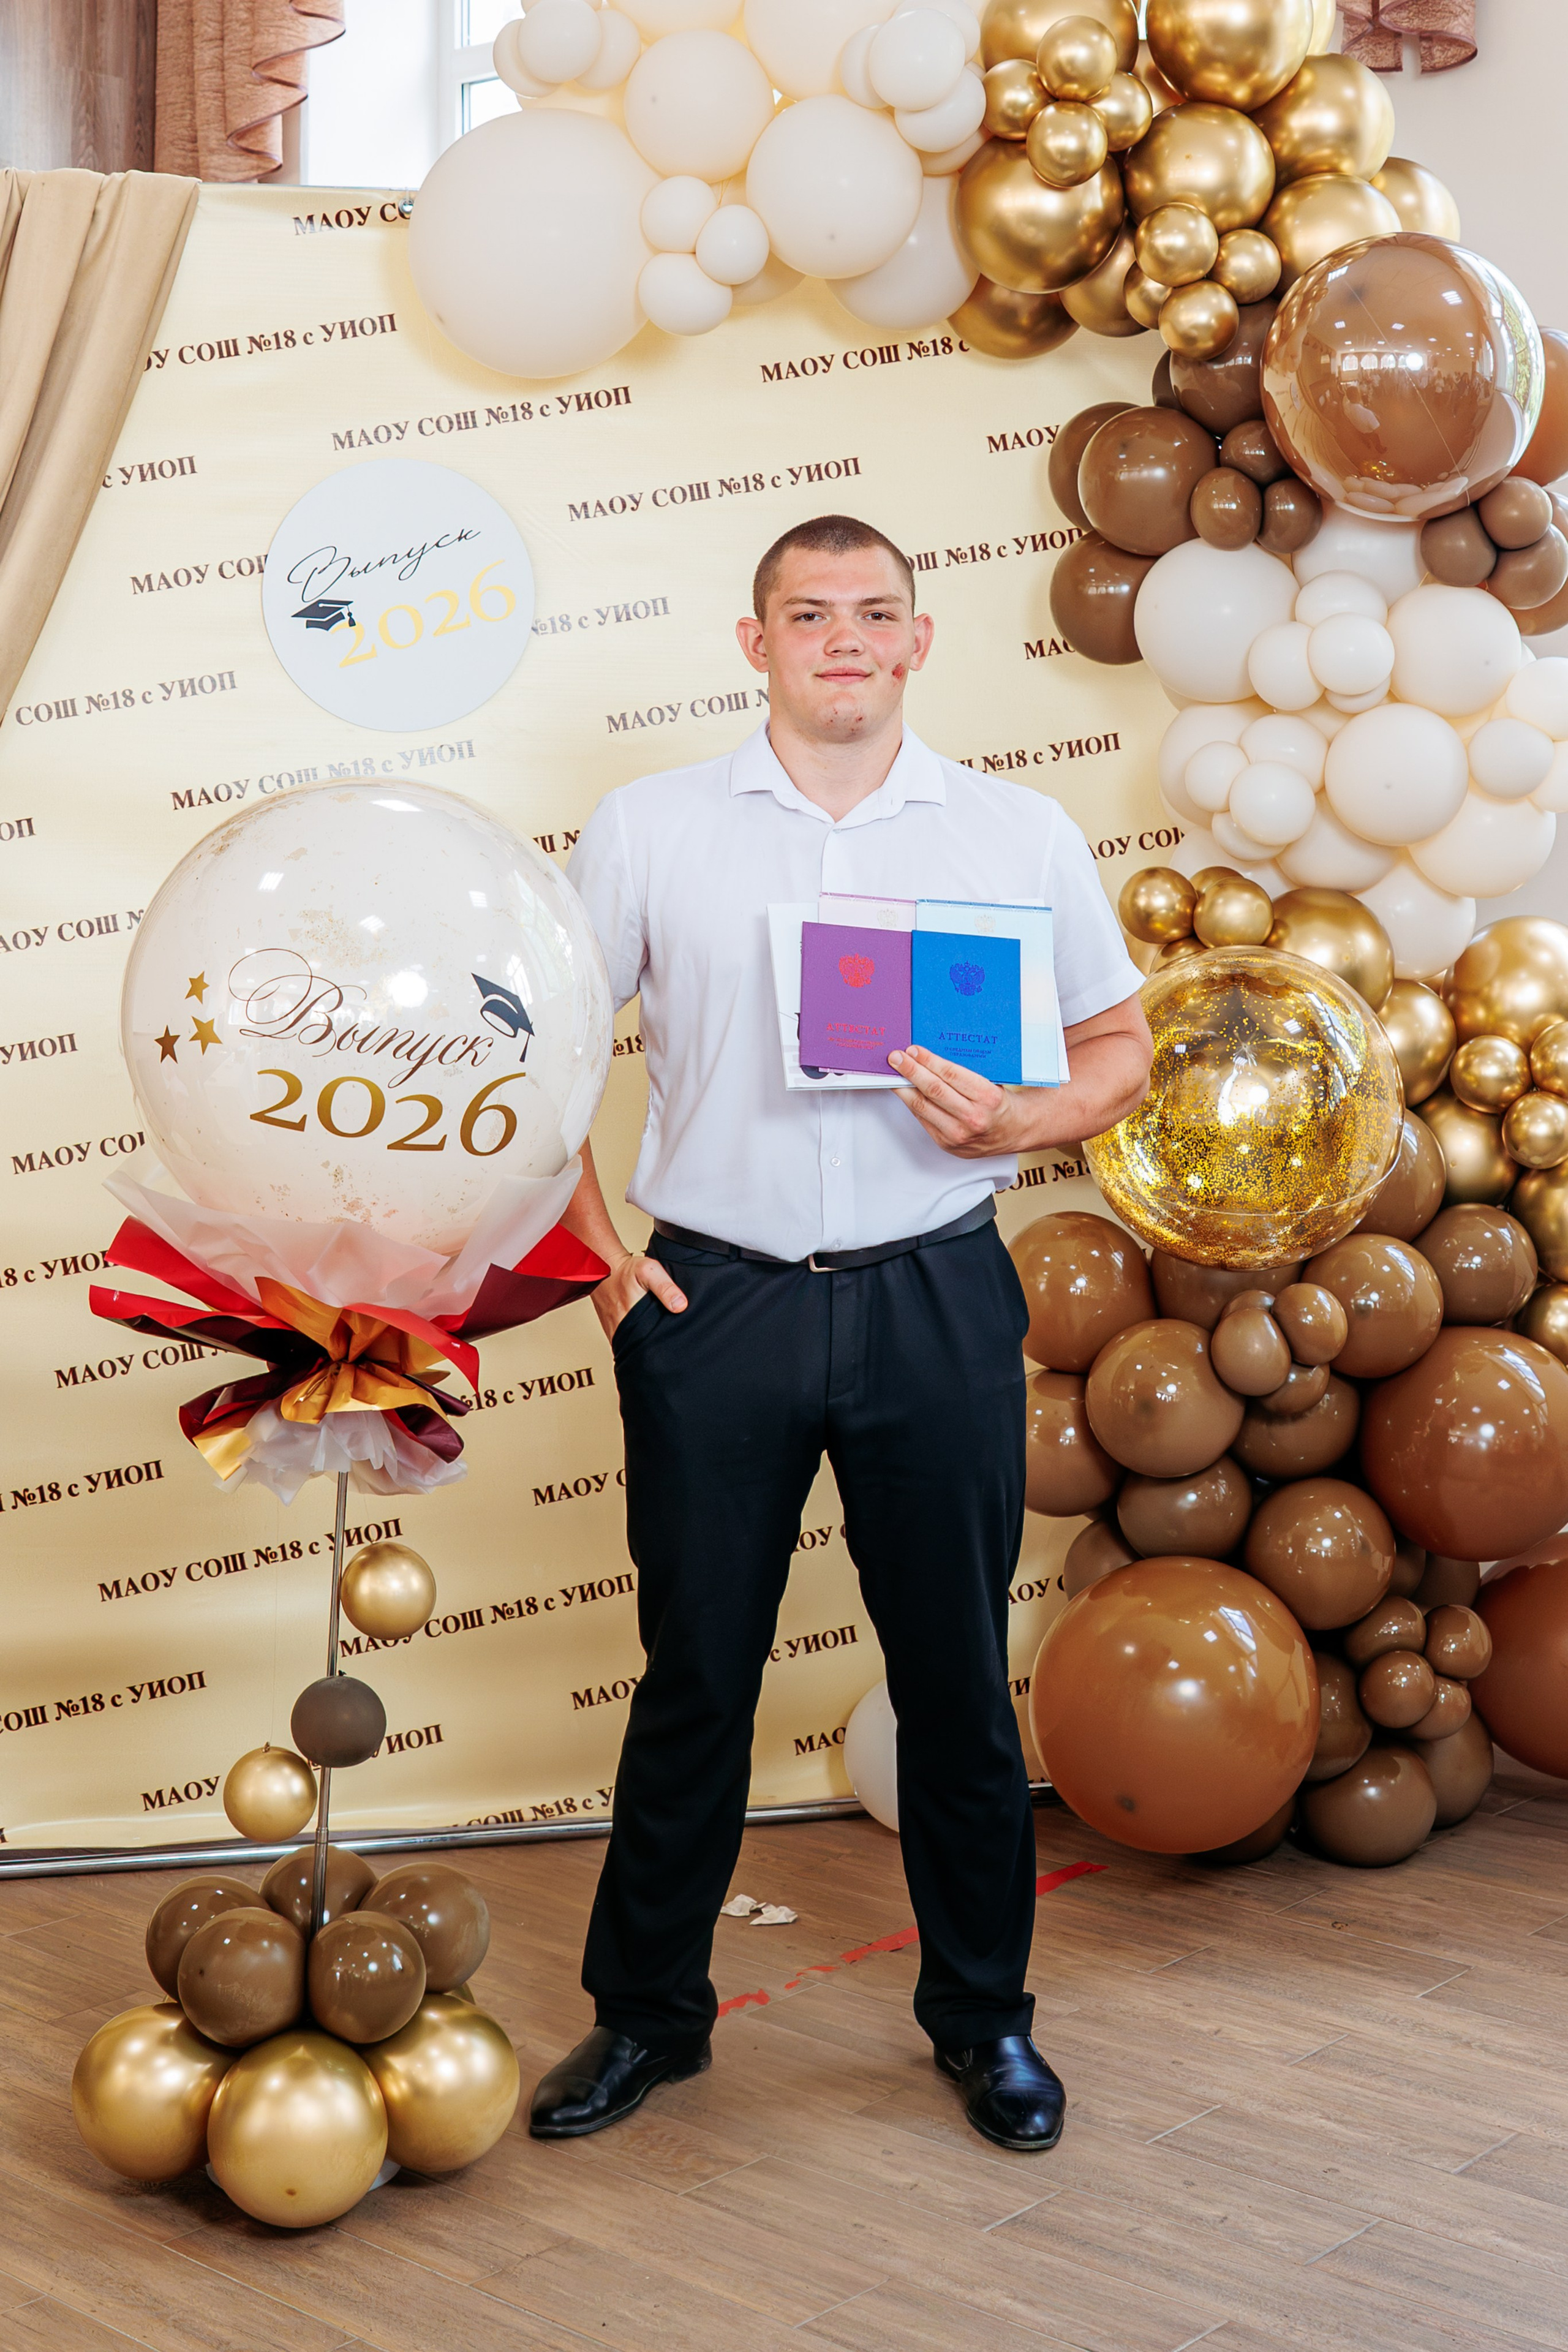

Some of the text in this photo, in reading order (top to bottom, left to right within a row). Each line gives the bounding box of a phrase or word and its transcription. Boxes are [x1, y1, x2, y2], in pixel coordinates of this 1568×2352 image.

[293, 206, 371, 235] МАОУ
[179, 339, 240, 364] СОШ
[247, 330, 296, 354] №18
[303, 330, 315, 346] с
[320, 314, 397, 342] УИОП
[761, 355, 834, 382] МАОУ
[843, 344, 900, 369] СОШ
[907, 337, 953, 360] №18
[332, 386, 631, 450] МАОУ СОШ №18 с УИОП
[986, 425, 1060, 454] МАОУ
[102, 456, 198, 489] с УИОП
[568, 458, 861, 521] МАОУ СОШ №18 с УИОП
[287, 527, 481, 603] Выпуск
[909, 552, 939, 573] ОШ
[944, 543, 990, 567] №18
[997, 546, 1007, 557] с
[130, 565, 209, 594] МАОУ
[331, 559, 516, 668] 2026
[578, 616, 588, 628] с
[594, 597, 670, 625] УИОП
[1023, 637, 1076, 660] МА
[15, 671, 237, 725] СОШ №18 с УИОП
[606, 703, 682, 733] МАОУ
[690, 692, 749, 717] СОШ
[982, 750, 1027, 773] №18
[1033, 752, 1043, 764] с
[1048, 733, 1120, 761] УИОП
[170, 739, 477, 810] МАОУ СОШ №18 с УИОП
[0, 818, 35, 840] ОП
[1088, 836, 1131, 859] ОУ
[0, 927, 48, 952] АОУ
[58, 914, 119, 941] СОШ
[228, 948, 494, 1088] Выпуск
[827, 1022, 886, 1036] АТТЕСТАТ
[0, 1033, 78, 1065] УИОП
[938, 1032, 998, 1044] АТТЕСТАТ
[249, 1069, 527, 1156] 2026
[12, 1132, 145, 1174] МАОУ СО
[995, 1160, 1090, 1194] ОШ №1
[24, 1270, 36, 1283] с
[54, 1354, 134, 1388] МАОУ
[142, 1343, 205, 1370] СОШ
[503, 1391, 514, 1403] с
[518, 1368, 595, 1400] УИОП
[10, 1482, 61, 1509] №18
[68, 1484, 79, 1497] с
[84, 1460, 164, 1493] УИОП
[532, 1472, 608, 1506] МАОУ
[794, 1526, 833, 1552] ОУ
[97, 1567, 178, 1602] МАОУ
[186, 1552, 247, 1581] СОШ
[253, 1540, 303, 1567] №18
[309, 1542, 320, 1555] с
[424, 1608, 484, 1637] СОШ
[490, 1597, 538, 1624] №18
[544, 1598, 556, 1610] с
[559, 1574, 635, 1607] УИОП
[770, 1625, 858, 1662] с УИОП
[54, 1694, 105, 1721] №18
[111, 1694, 123, 1707] с
[126, 1671, 206, 1703] УИОП
[371, 1724, 445, 1758] ИОП
[794, 1727, 846, 1755] МАО
[141, 1776, 220, 1811] МАОУ
[530, 1796, 578, 1821] №18
[582, 1798, 594, 1810] с
